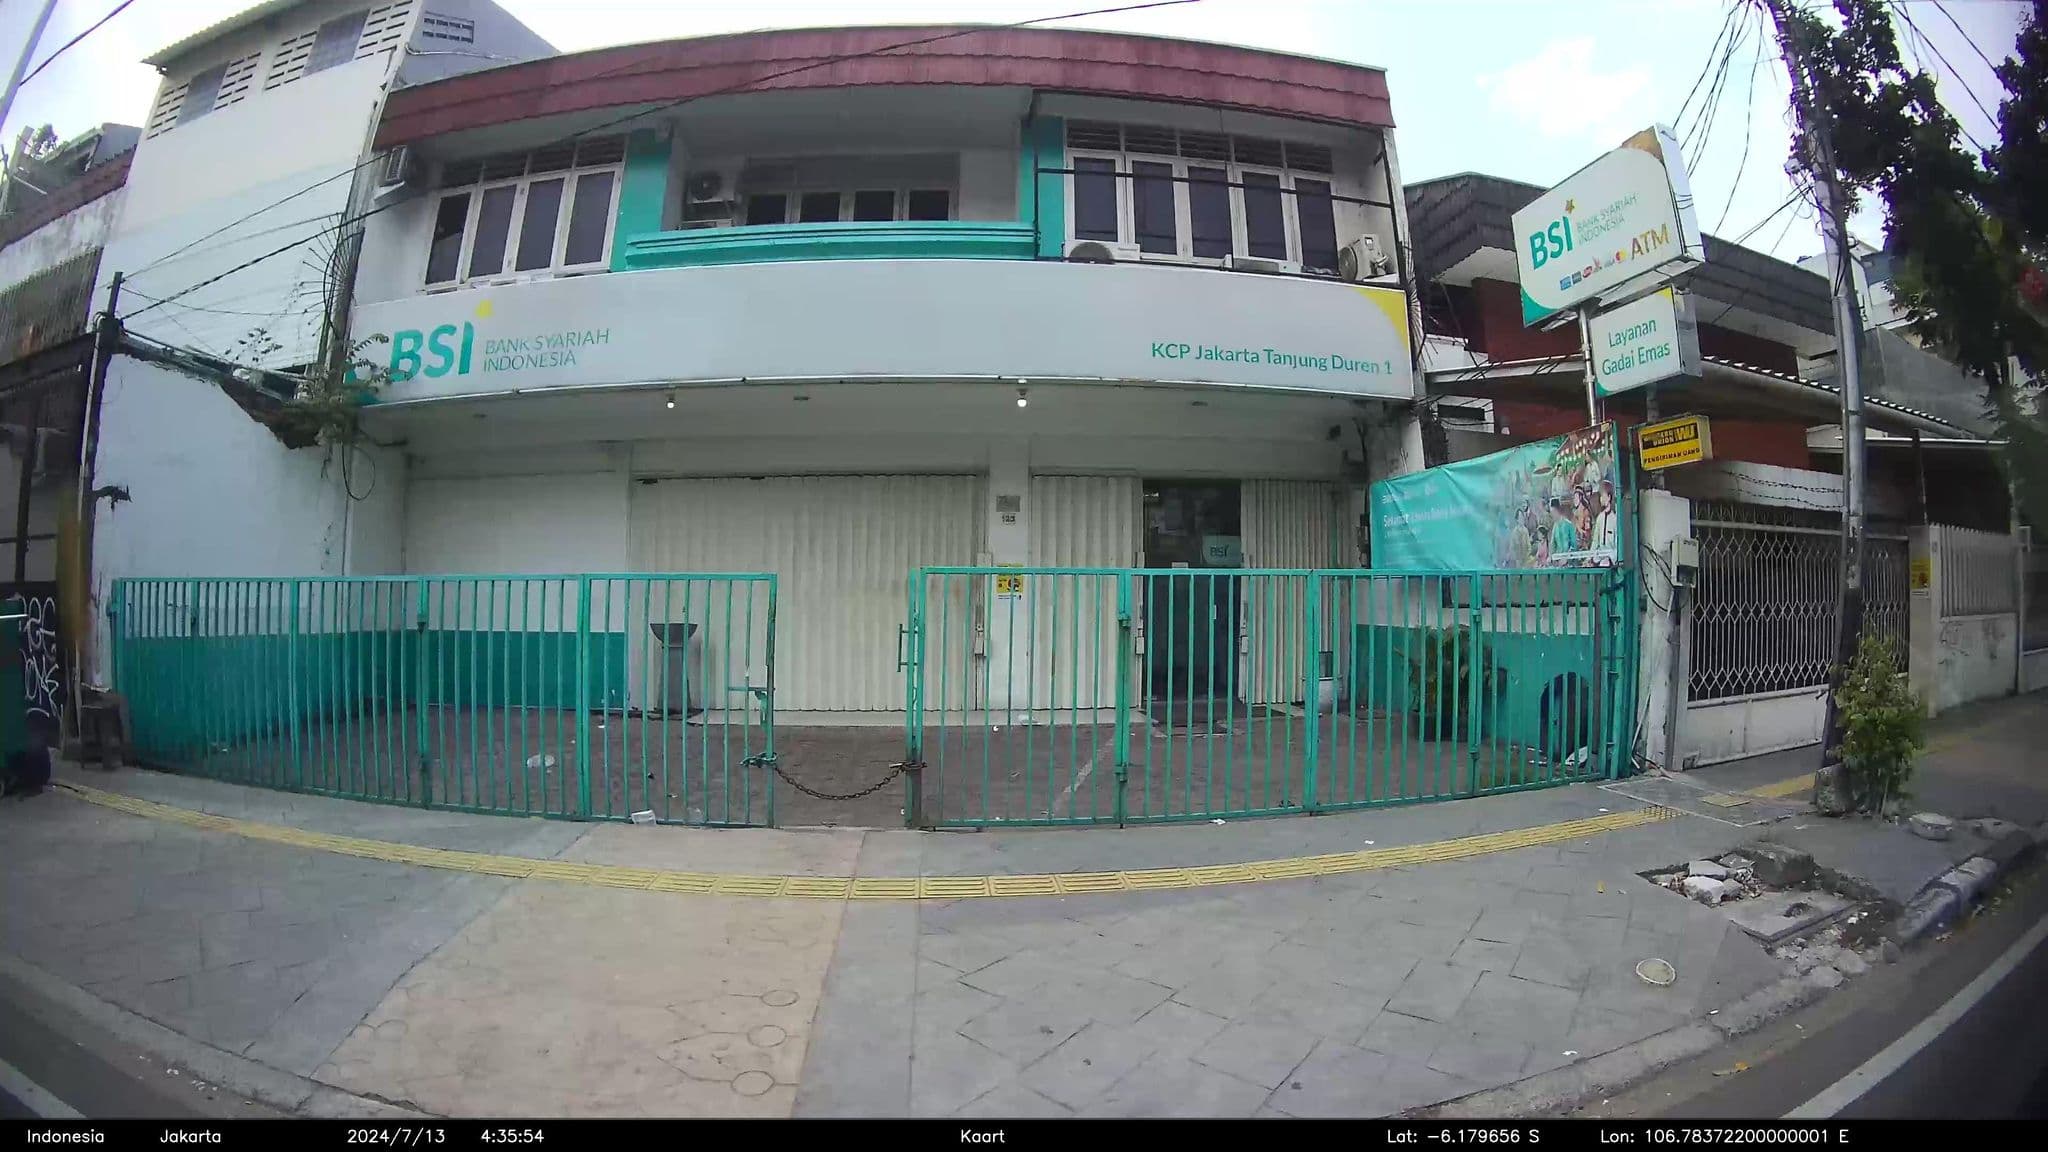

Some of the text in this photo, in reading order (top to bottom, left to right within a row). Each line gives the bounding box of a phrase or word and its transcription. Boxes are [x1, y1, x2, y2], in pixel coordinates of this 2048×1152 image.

[1577, 194, 1637, 231] BANK SYARIAH
[1530, 216, 1573, 270] BSI
[1579, 216, 1625, 244] INDONESIA
[1631, 223, 1670, 260] ATM
[485, 328, 610, 355] BANK SYARIAH
[1608, 319, 1657, 348] Layanan
[390, 321, 475, 383] BSI
[483, 351, 577, 373] INDONESIA
[1151, 342, 1393, 375] KCP Jakarta Tanjung Duren 1
[1602, 342, 1671, 376] Gadai Emas
